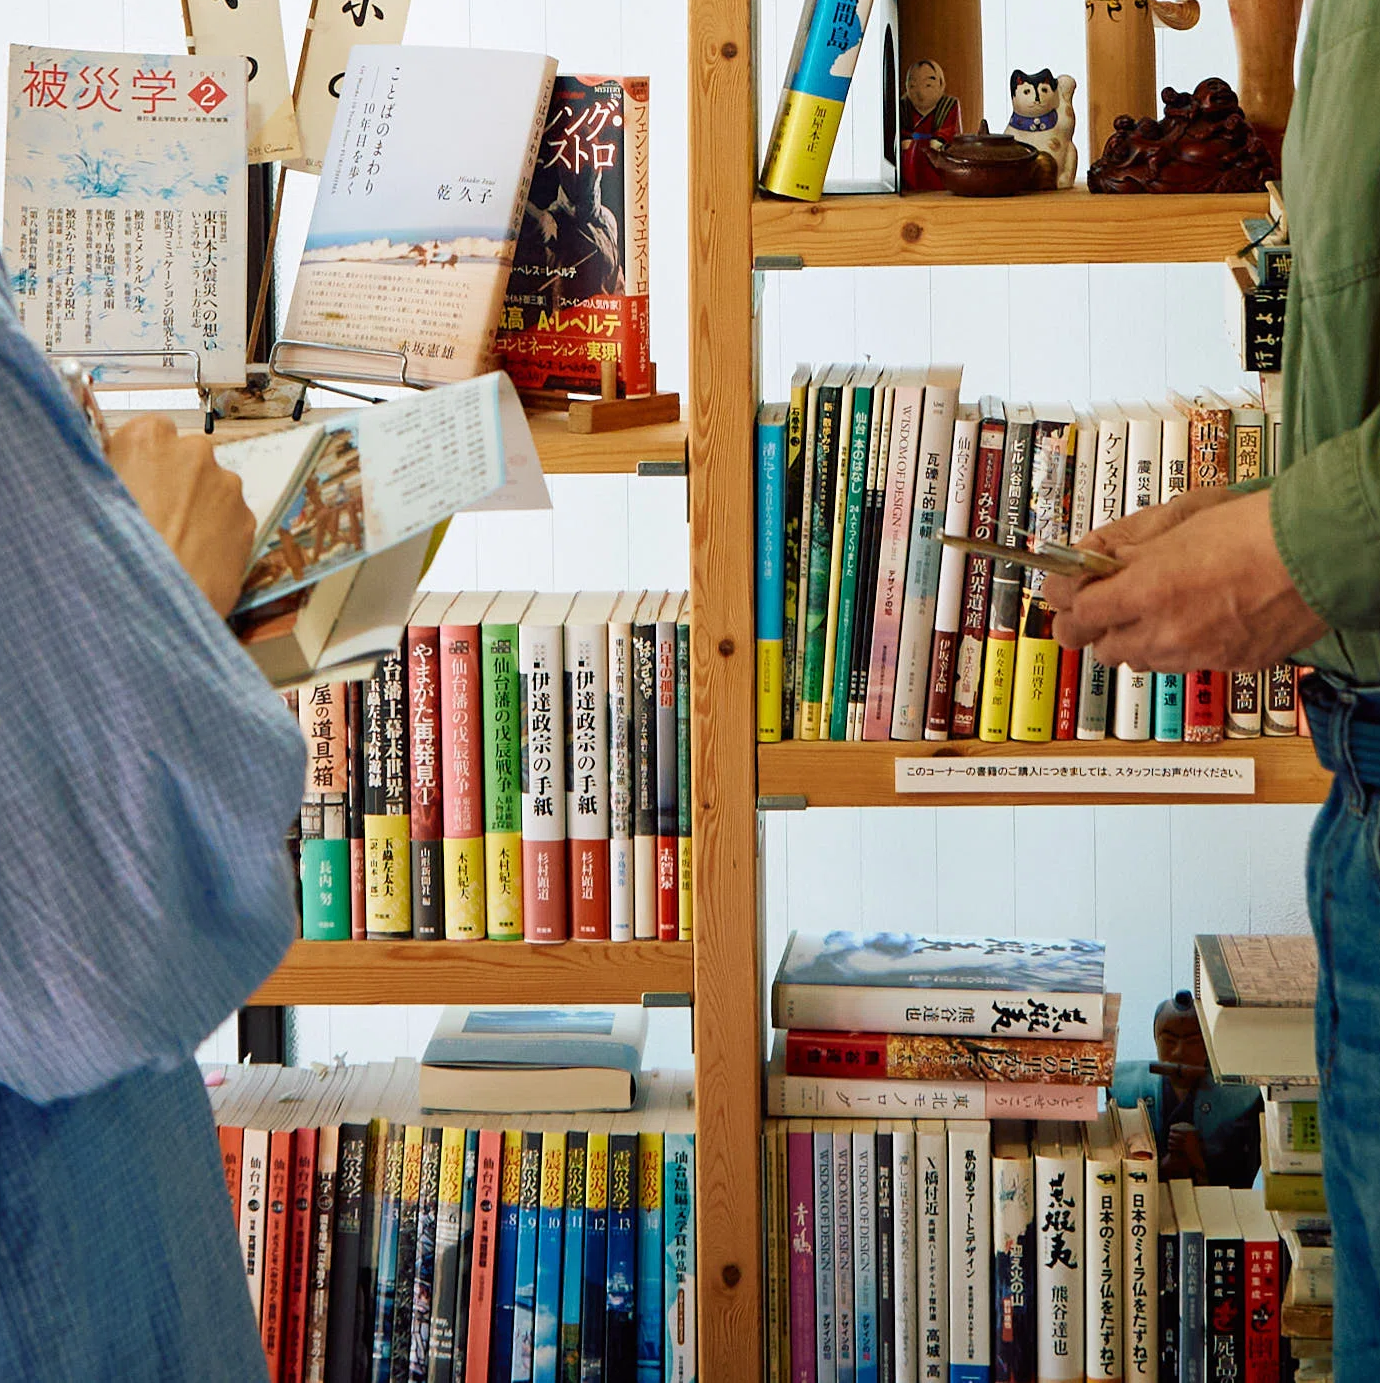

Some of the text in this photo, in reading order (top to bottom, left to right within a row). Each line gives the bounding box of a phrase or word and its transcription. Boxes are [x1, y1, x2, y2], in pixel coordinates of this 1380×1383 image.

[22, 61, 177, 114] 被災学
[199, 83, 217, 107] 2
[365, 66, 400, 196] ことばのまわり
[436, 183, 493, 204] 乾久子
[633, 105, 649, 293] フェンシング・マエストロ
[64, 208, 77, 321] 被災から生まれる視点
[103, 209, 116, 310] 能登半島地震と豪雨
[133, 210, 146, 314] 被災とメンタルヘルス
[202, 210, 218, 351] 東日本大震災への想い
[847, 411, 868, 576] 仙台 本のはなし 24人でつくりました
[892, 404, 912, 528] WISDOM OF DESIGN
[954, 436, 970, 504] 仙台ぐらし
[1103, 432, 1122, 521] ケンタウロス
[450, 657, 471, 794] 仙台藩の戊辰戦争
[493, 656, 512, 793] 仙台藩の戊辰戦争
[531, 671, 554, 817] 伊達政宗の手紙
[576, 670, 598, 815] 伊達政宗の手紙
[907, 765, 1245, 779] このコーナーの書籍のご購入につきましては、スタッフにお声がけください。
[457, 851, 470, 901] 木村紀夫
[498, 846, 512, 896] 木村紀夫
[904, 1005, 976, 1024] 熊谷達也
[834, 1089, 971, 1110] 東北モノローグ
[339, 1139, 364, 1203] 震災学
[819, 1149, 831, 1204] WISDOM
[821, 1204, 832, 1226] OF
[838, 1149, 851, 1272] WISDOM OF DESIGN
[858, 1150, 871, 1272] WISDOM OF DESIGN
[508, 1212, 517, 1227] 8
[528, 1217, 536, 1229] 9
[548, 1216, 561, 1229] 10
[593, 1217, 606, 1231] 12
[618, 1217, 631, 1230] 13
[674, 1150, 688, 1284] 仙台短編文学賞作品集
[820, 1227, 832, 1272] DESIGN
[1041, 1172, 1078, 1356] 荒蝦夷 熊谷達也
[1098, 1194, 1116, 1376] 日本のミイラ仏をたずねて
[1130, 1193, 1148, 1374] 日本のミイラ仏をたずねて
